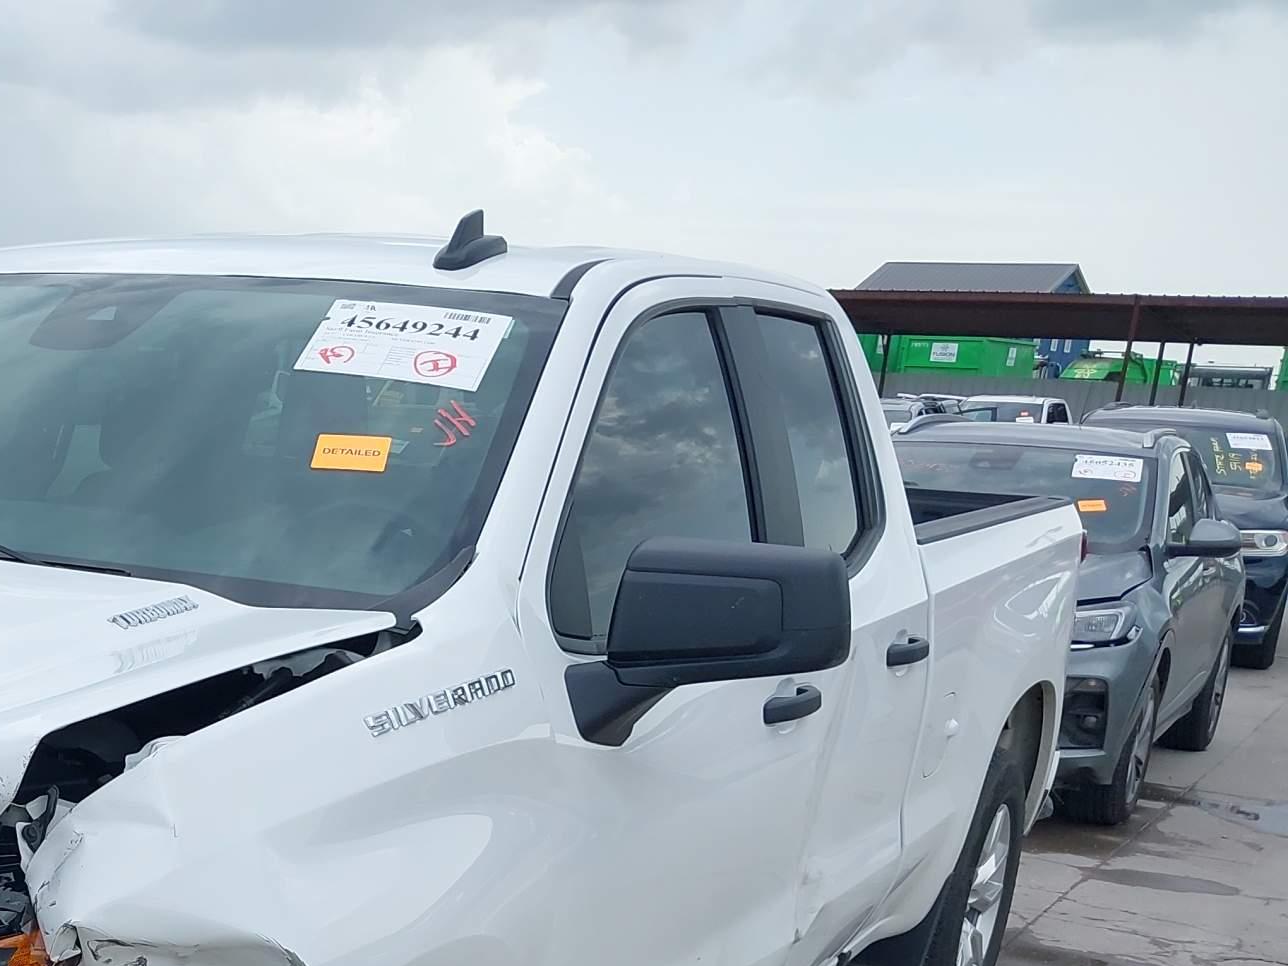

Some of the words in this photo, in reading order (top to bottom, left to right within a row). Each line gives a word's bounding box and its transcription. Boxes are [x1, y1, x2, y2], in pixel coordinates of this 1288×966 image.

[340, 313, 481, 342] 45649244
[321, 447, 381, 458] DETAILED
[363, 668, 516, 738] SILVERADO
